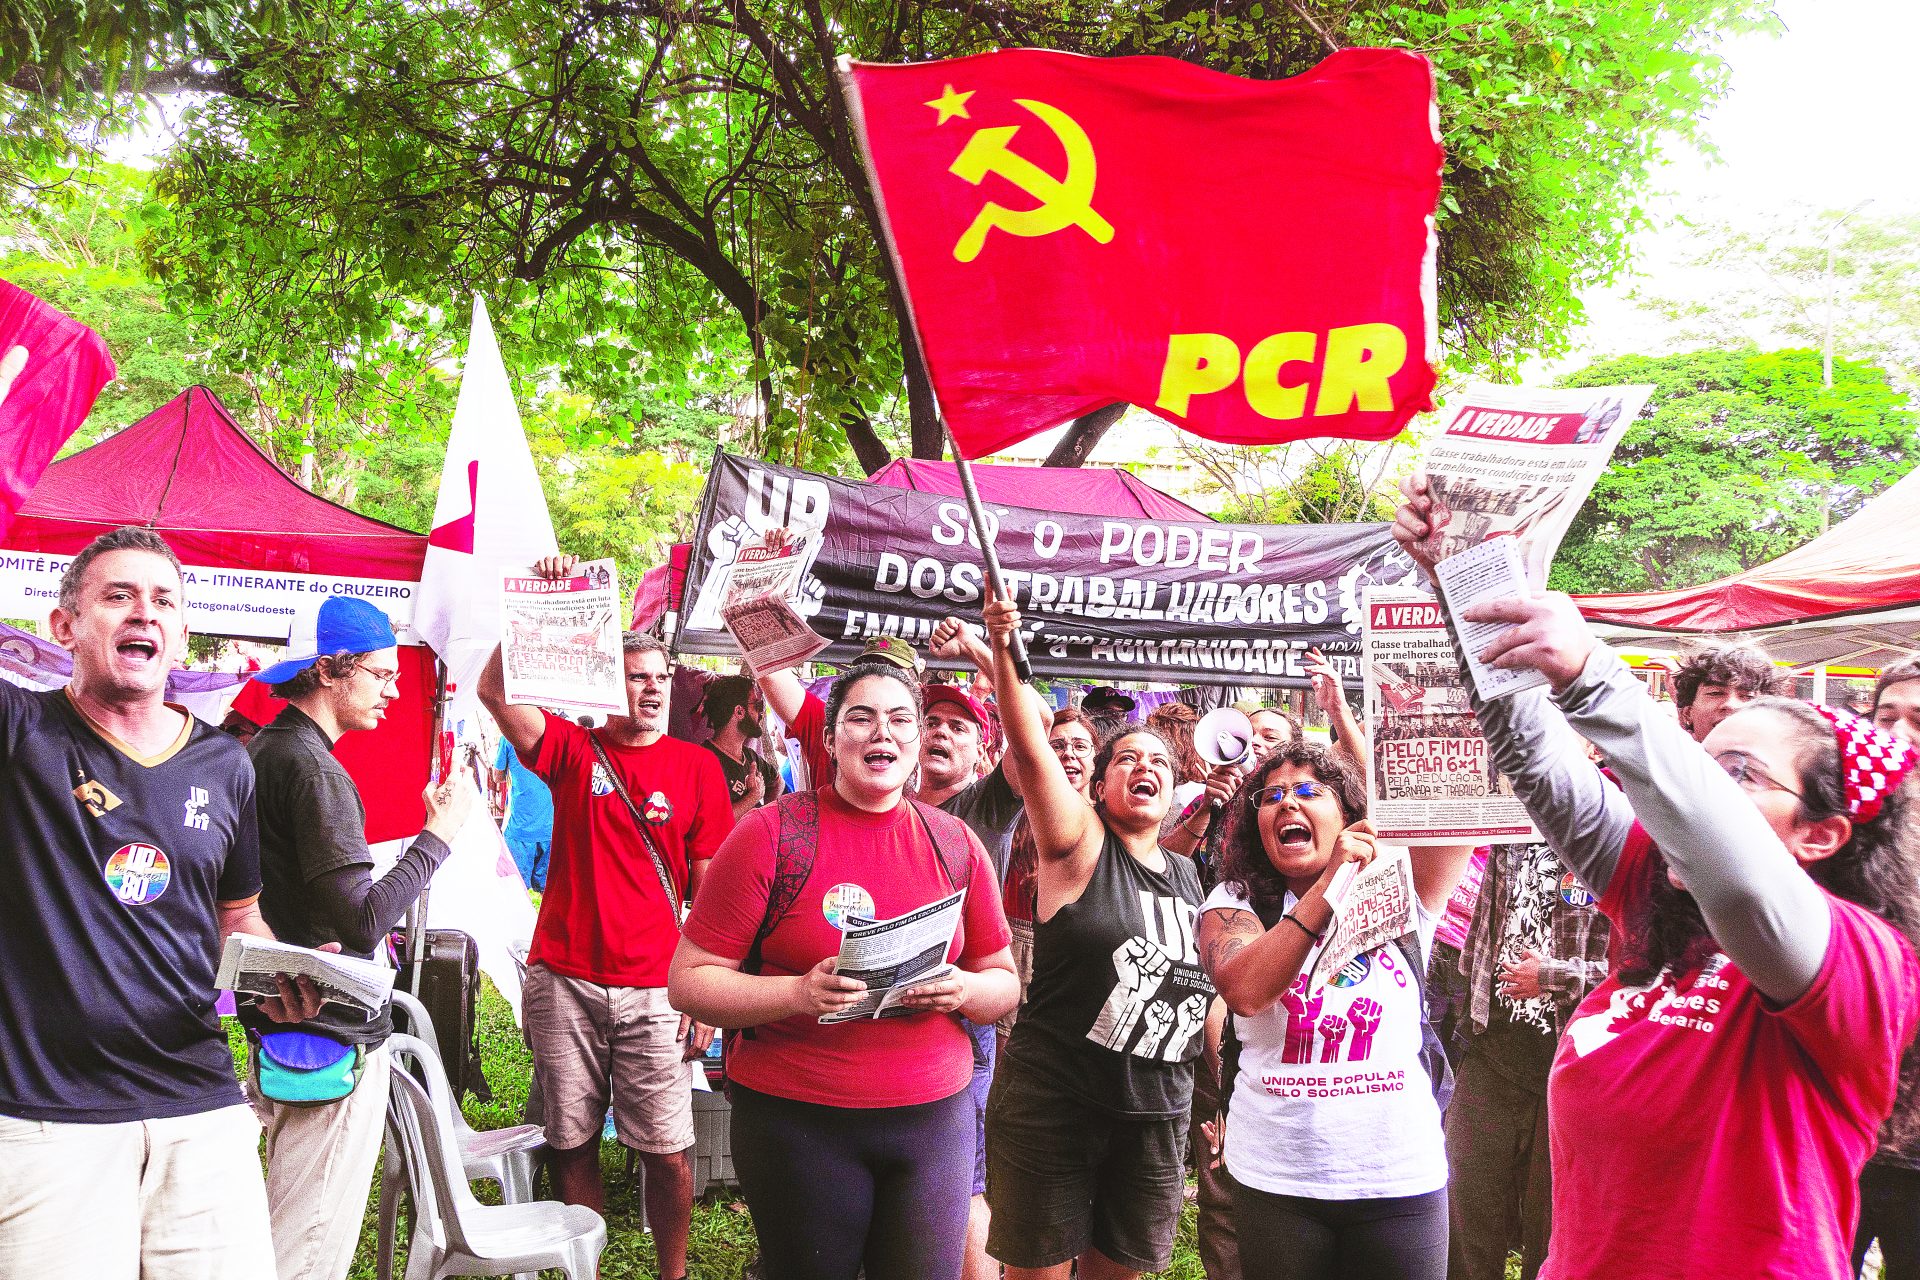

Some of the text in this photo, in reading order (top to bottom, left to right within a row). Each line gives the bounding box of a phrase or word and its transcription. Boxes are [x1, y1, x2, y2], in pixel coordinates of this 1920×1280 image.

[1155, 323, 1407, 420] PCR
[1451, 410, 1561, 440] A VERDADE
[1430, 447, 1588, 469] Classe trabalhadora está em luta
[1443, 463, 1487, 476] melhores
[1488, 468, 1539, 482] condições
[1540, 471, 1554, 483] de
[1556, 473, 1575, 483] vida
[745, 469, 829, 532] UP
[1033, 520, 1064, 558] O
[1100, 521, 1264, 574] PODER
[213, 574, 305, 592] ITINERANTE
[309, 582, 328, 593] do
[332, 583, 411, 599] CRUZEIRO
[506, 580, 571, 592] A VERDADE
[874, 552, 1329, 624] DOS TRABALHADORES
[1374, 608, 1387, 626] A
[1371, 640, 1401, 649] Classe
[1092, 637, 1310, 677] HUMANIDADE
[1374, 653, 1390, 661] por
[1393, 650, 1438, 659] melhores
[1386, 741, 1424, 758] PELO
[1464, 740, 1483, 756] DA
[1387, 756, 1442, 775] ESCALA
[1388, 776, 1410, 787] PELA
[1416, 772, 1470, 784] REDUÇÃO
[190, 786, 209, 808] UP
[1444, 784, 1485, 796] TRABALHO
[127, 845, 157, 872] UP
[119, 875, 150, 902] 80
[1569, 887, 1587, 906] 80
[852, 929, 876, 938] GREVE
[876, 924, 894, 933] PELO
[1172, 975, 1188, 986] PELO
[1174, 967, 1201, 980] UNIDADE
[1707, 975, 1730, 990] de
[1262, 1071, 1404, 1086] UNIDADE POPULAR
[1265, 1082, 1404, 1097] PELO SOCIALISMO
